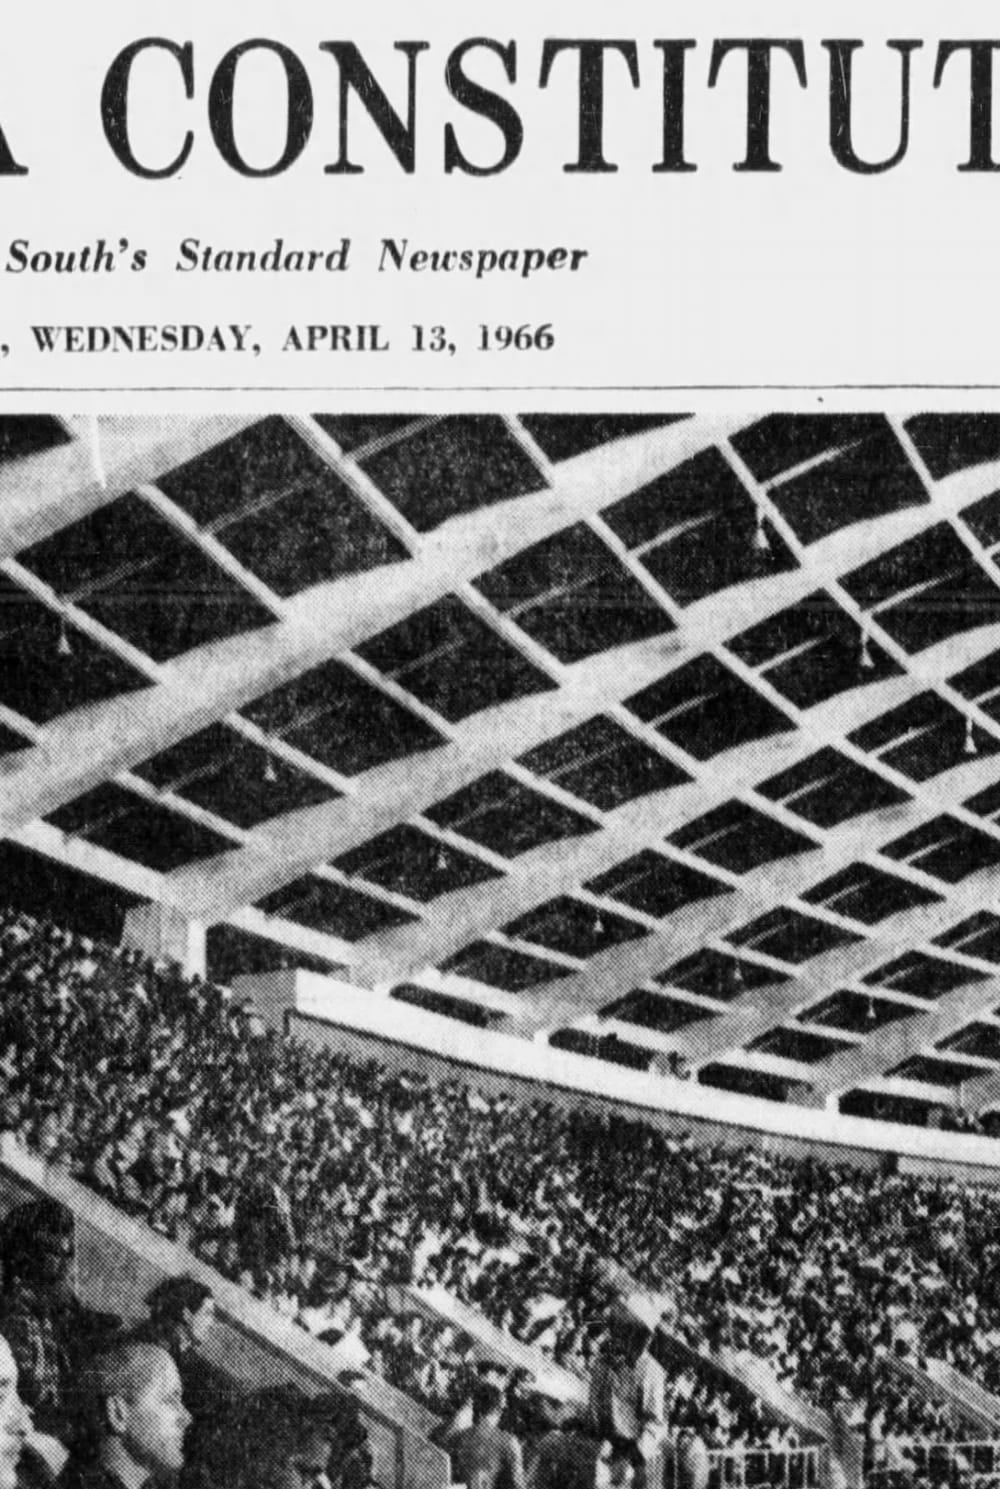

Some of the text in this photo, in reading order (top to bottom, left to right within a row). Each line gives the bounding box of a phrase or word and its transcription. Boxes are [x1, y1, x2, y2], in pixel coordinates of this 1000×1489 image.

[5, 237, 589, 279] South's Standard Newspaper
[30, 323, 555, 355] WEDNESDAY, APRIL 13, 1966
